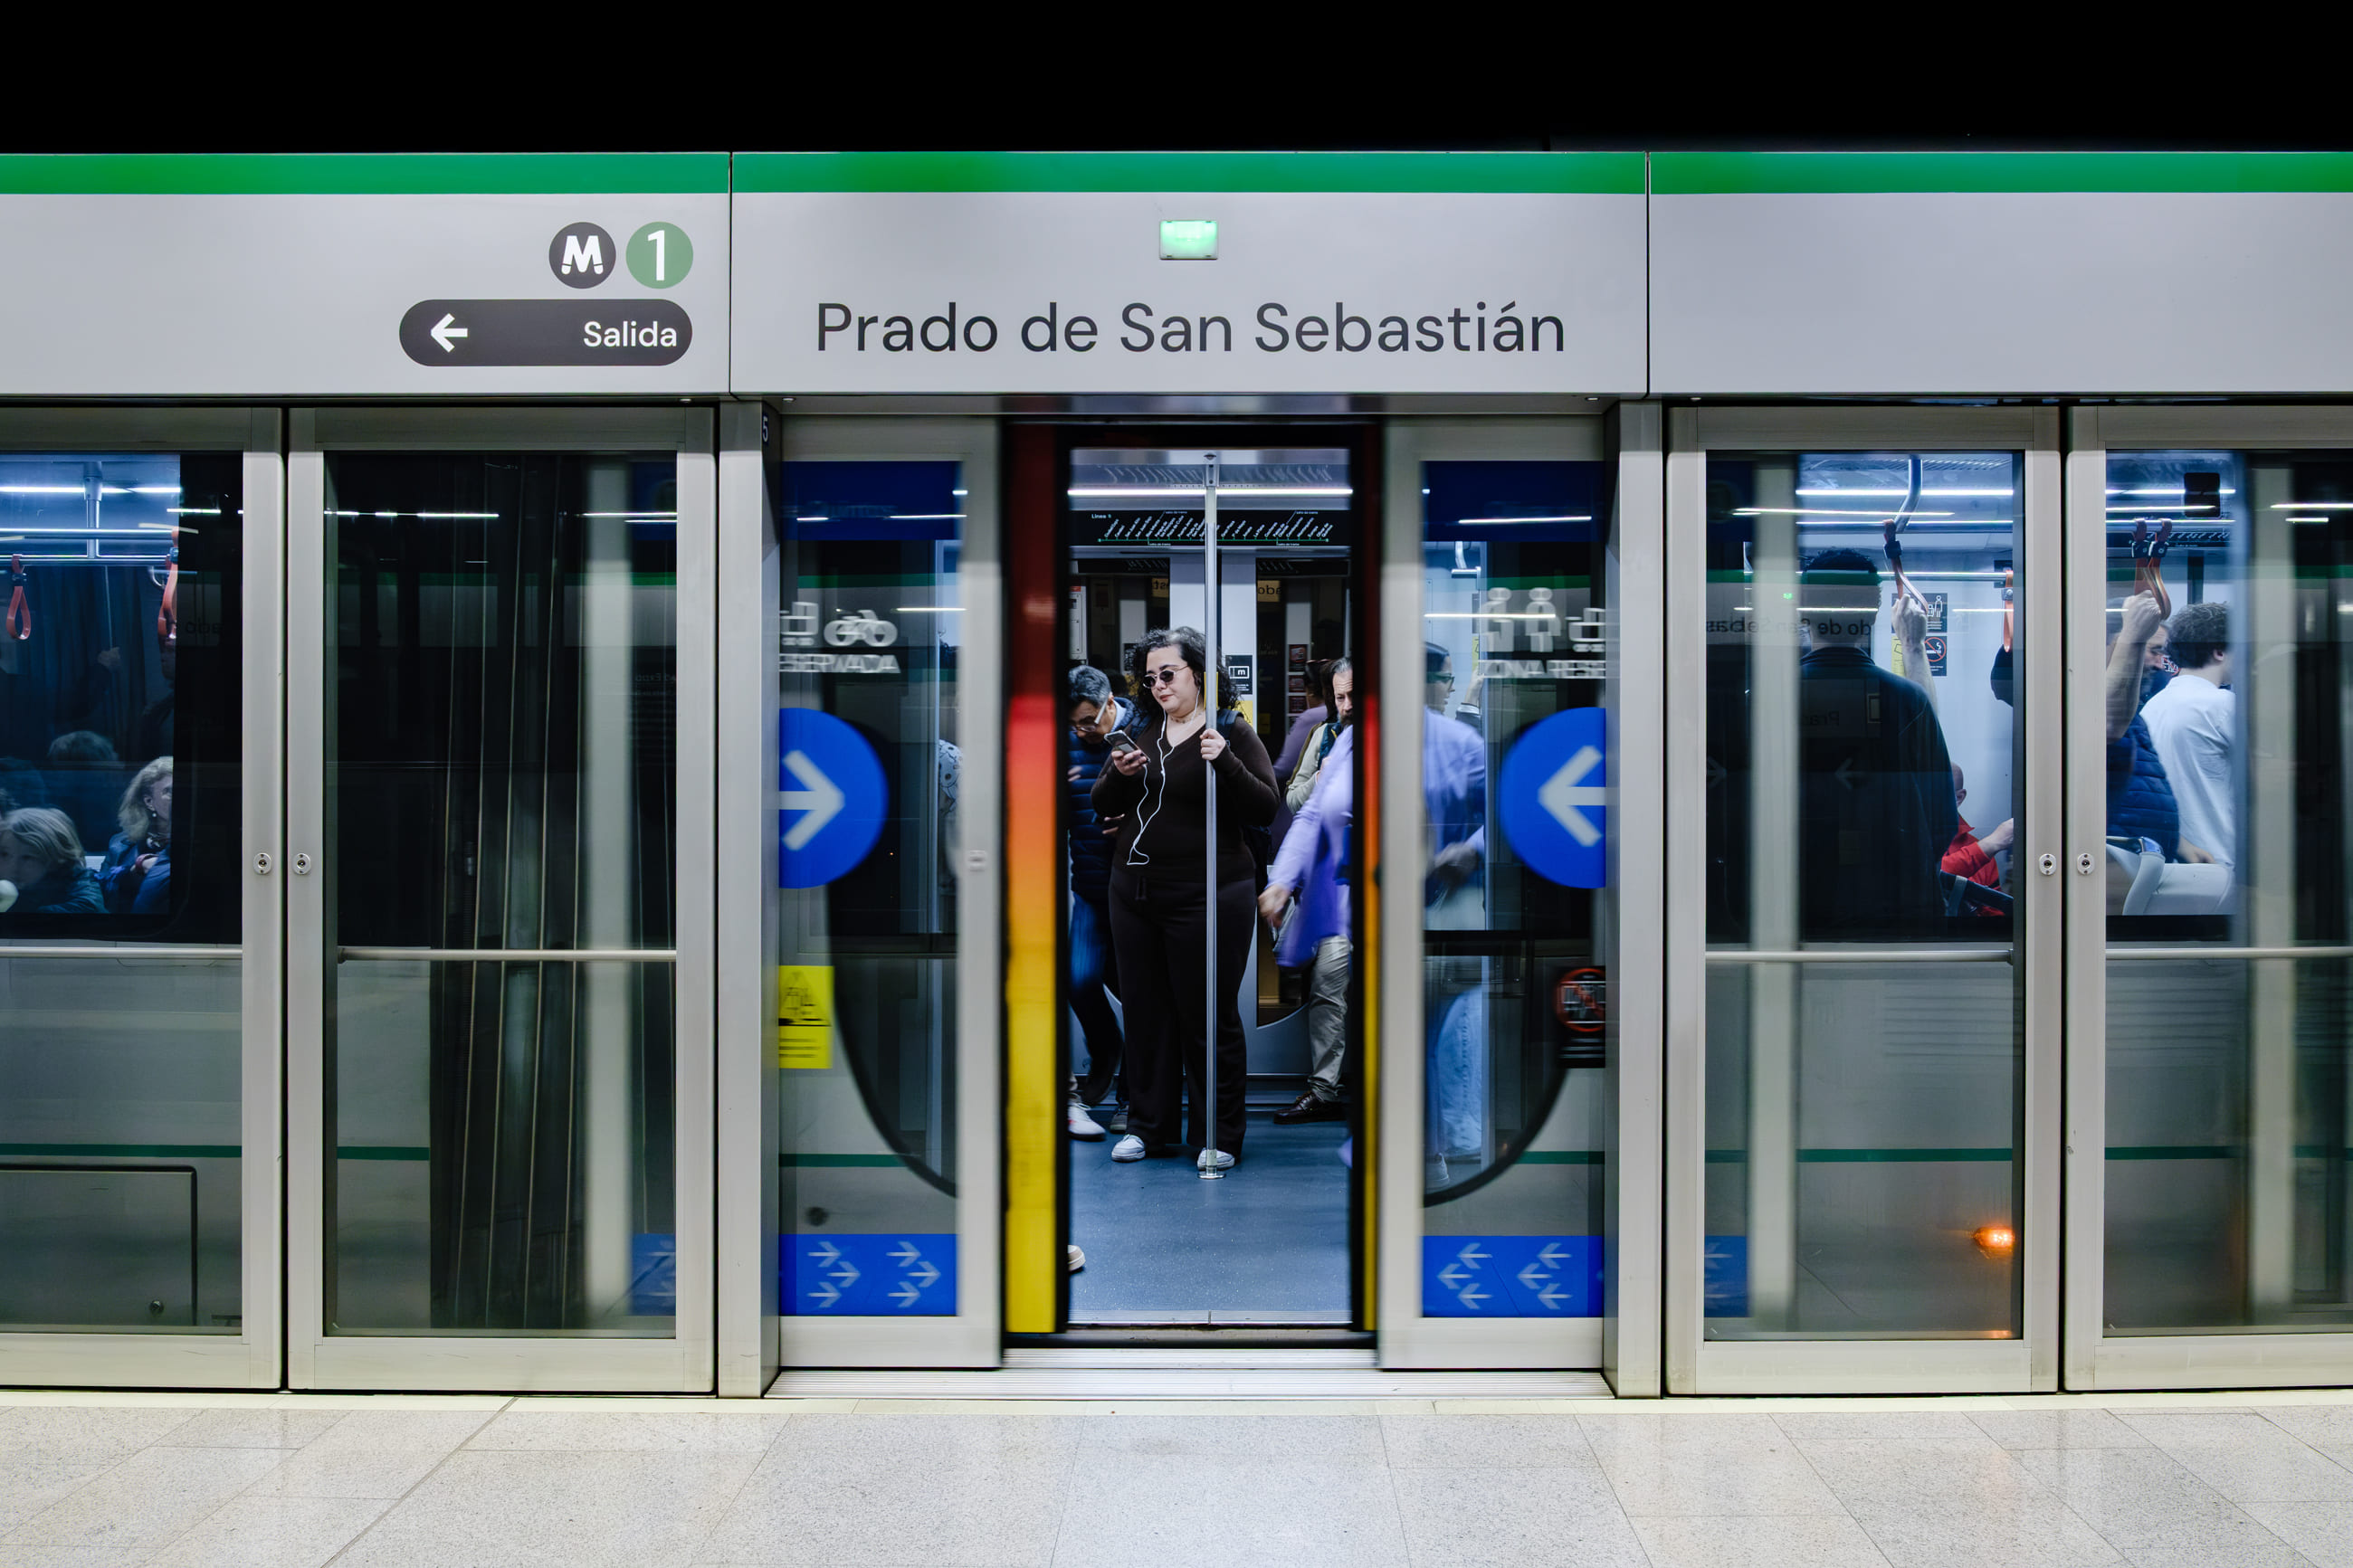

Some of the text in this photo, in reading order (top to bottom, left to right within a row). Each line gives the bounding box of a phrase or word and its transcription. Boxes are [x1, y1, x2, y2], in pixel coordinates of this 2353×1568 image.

[560, 229, 666, 281] M 1
[582, 319, 679, 350] Salida
[817, 300, 1565, 354] Prado de San Sebastián
